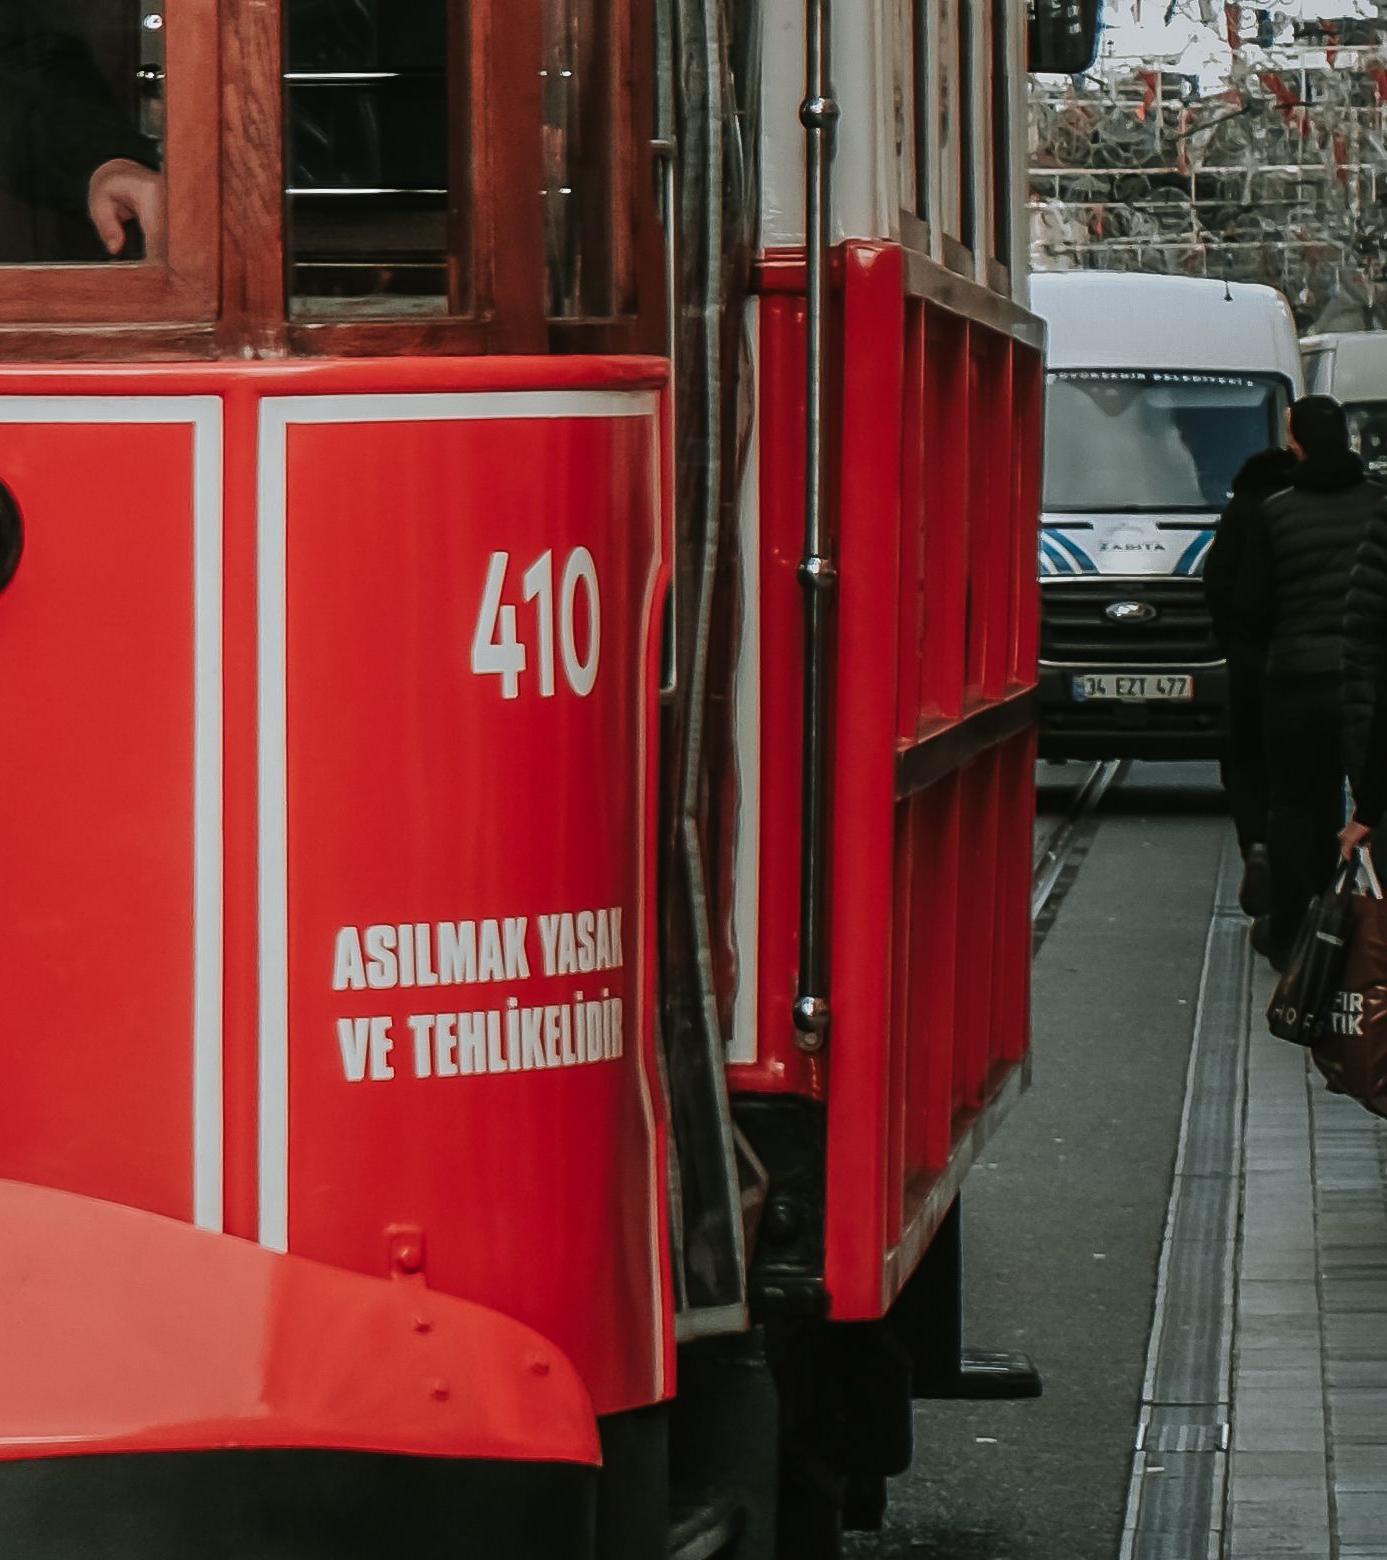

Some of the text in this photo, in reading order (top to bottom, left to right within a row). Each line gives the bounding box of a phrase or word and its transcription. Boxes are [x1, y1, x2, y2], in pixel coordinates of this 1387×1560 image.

[469, 545, 601, 699] 410
[332, 906, 623, 990] ASILMAK YASAK
[336, 987, 623, 1082] VE TEHLİKELİDİR
